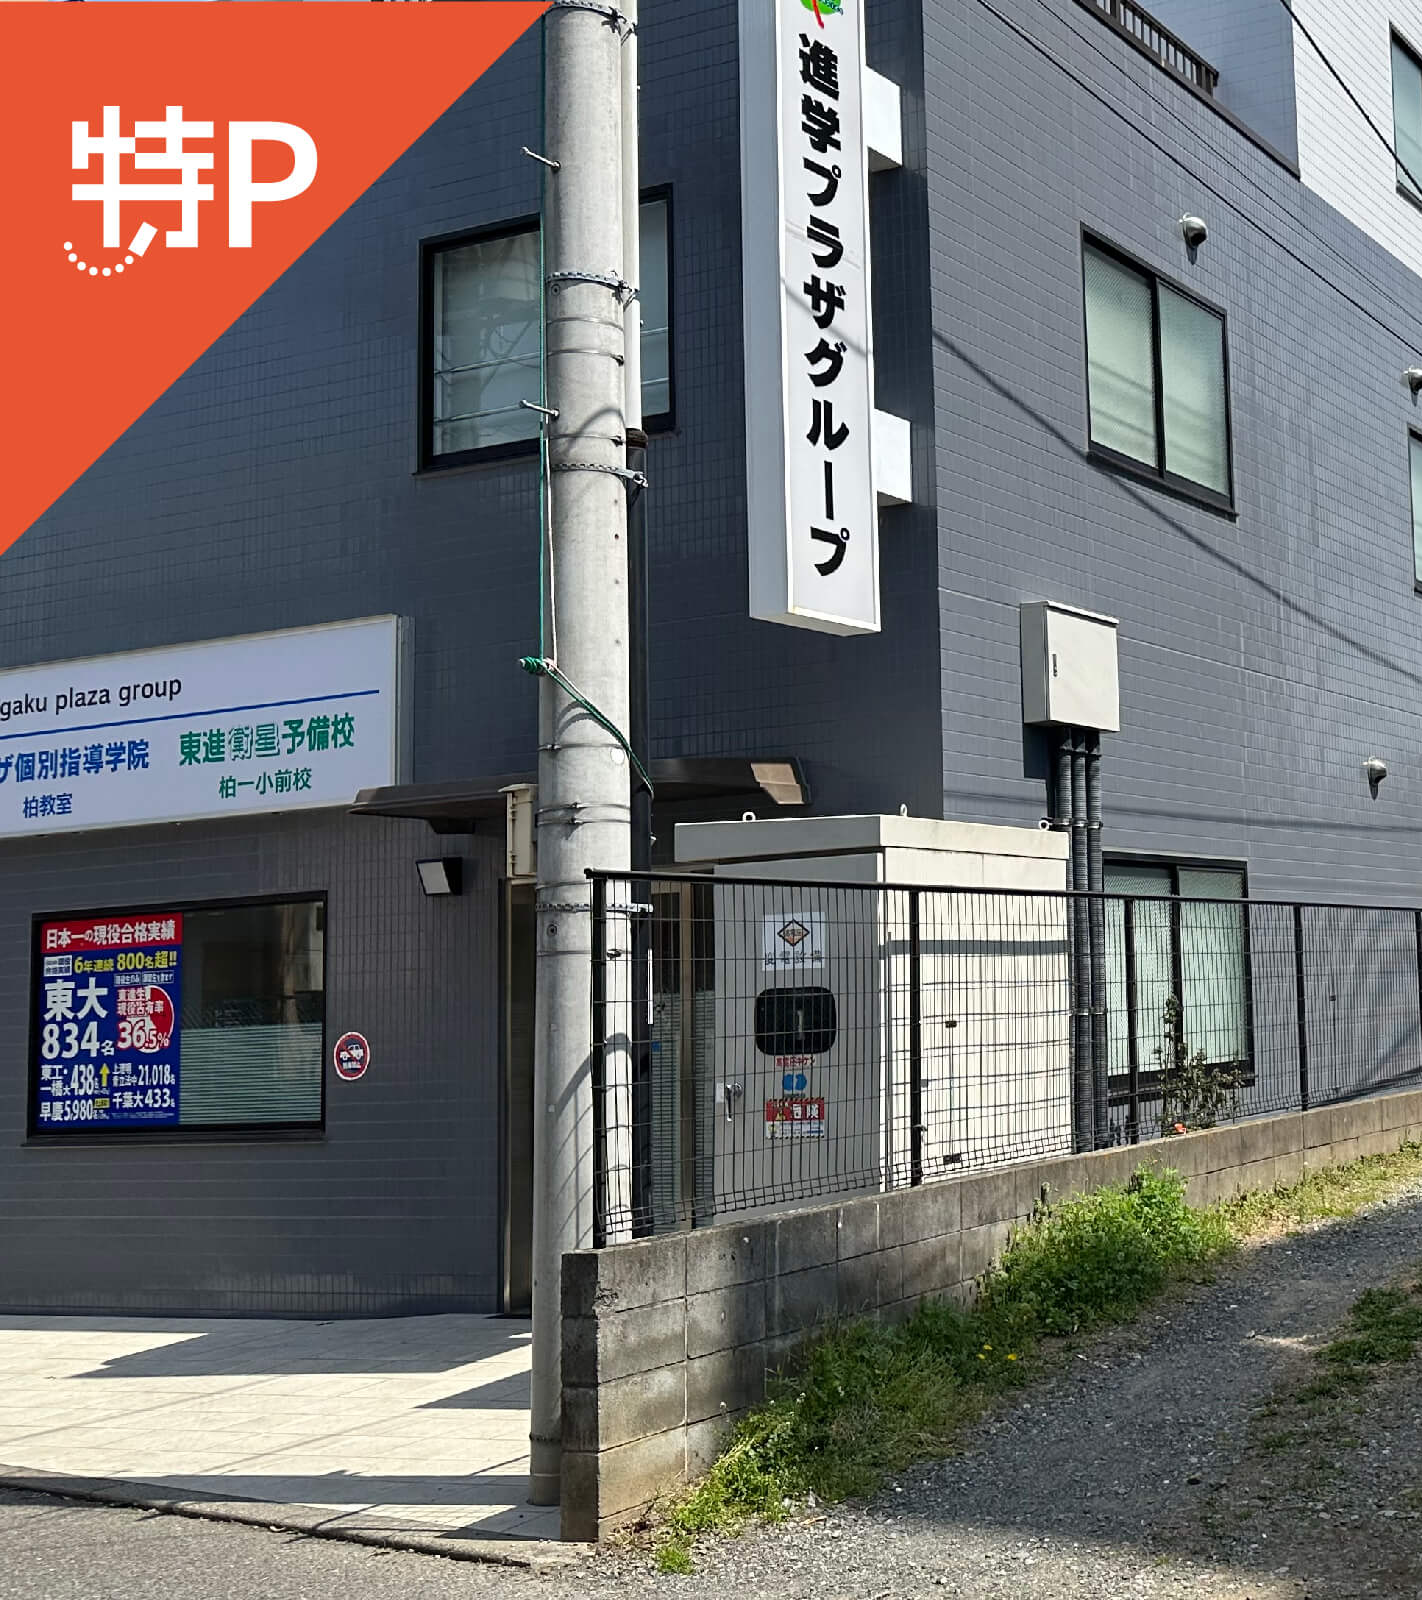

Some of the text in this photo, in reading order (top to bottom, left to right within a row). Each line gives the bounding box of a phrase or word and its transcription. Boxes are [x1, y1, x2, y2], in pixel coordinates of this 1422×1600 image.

[798, 33, 850, 578] 進学プラザグループ
[0, 678, 182, 721] gaku plaza group
[179, 712, 355, 766] 東進衛星予備校
[218, 768, 312, 799] 柏一小前校
[23, 793, 72, 818] 柏教室
[46, 919, 175, 949] 日本一の現役合格実績
[43, 977, 108, 1021] 東大
[41, 1021, 115, 1060] 834名
[117, 1020, 170, 1049] 36.5%
